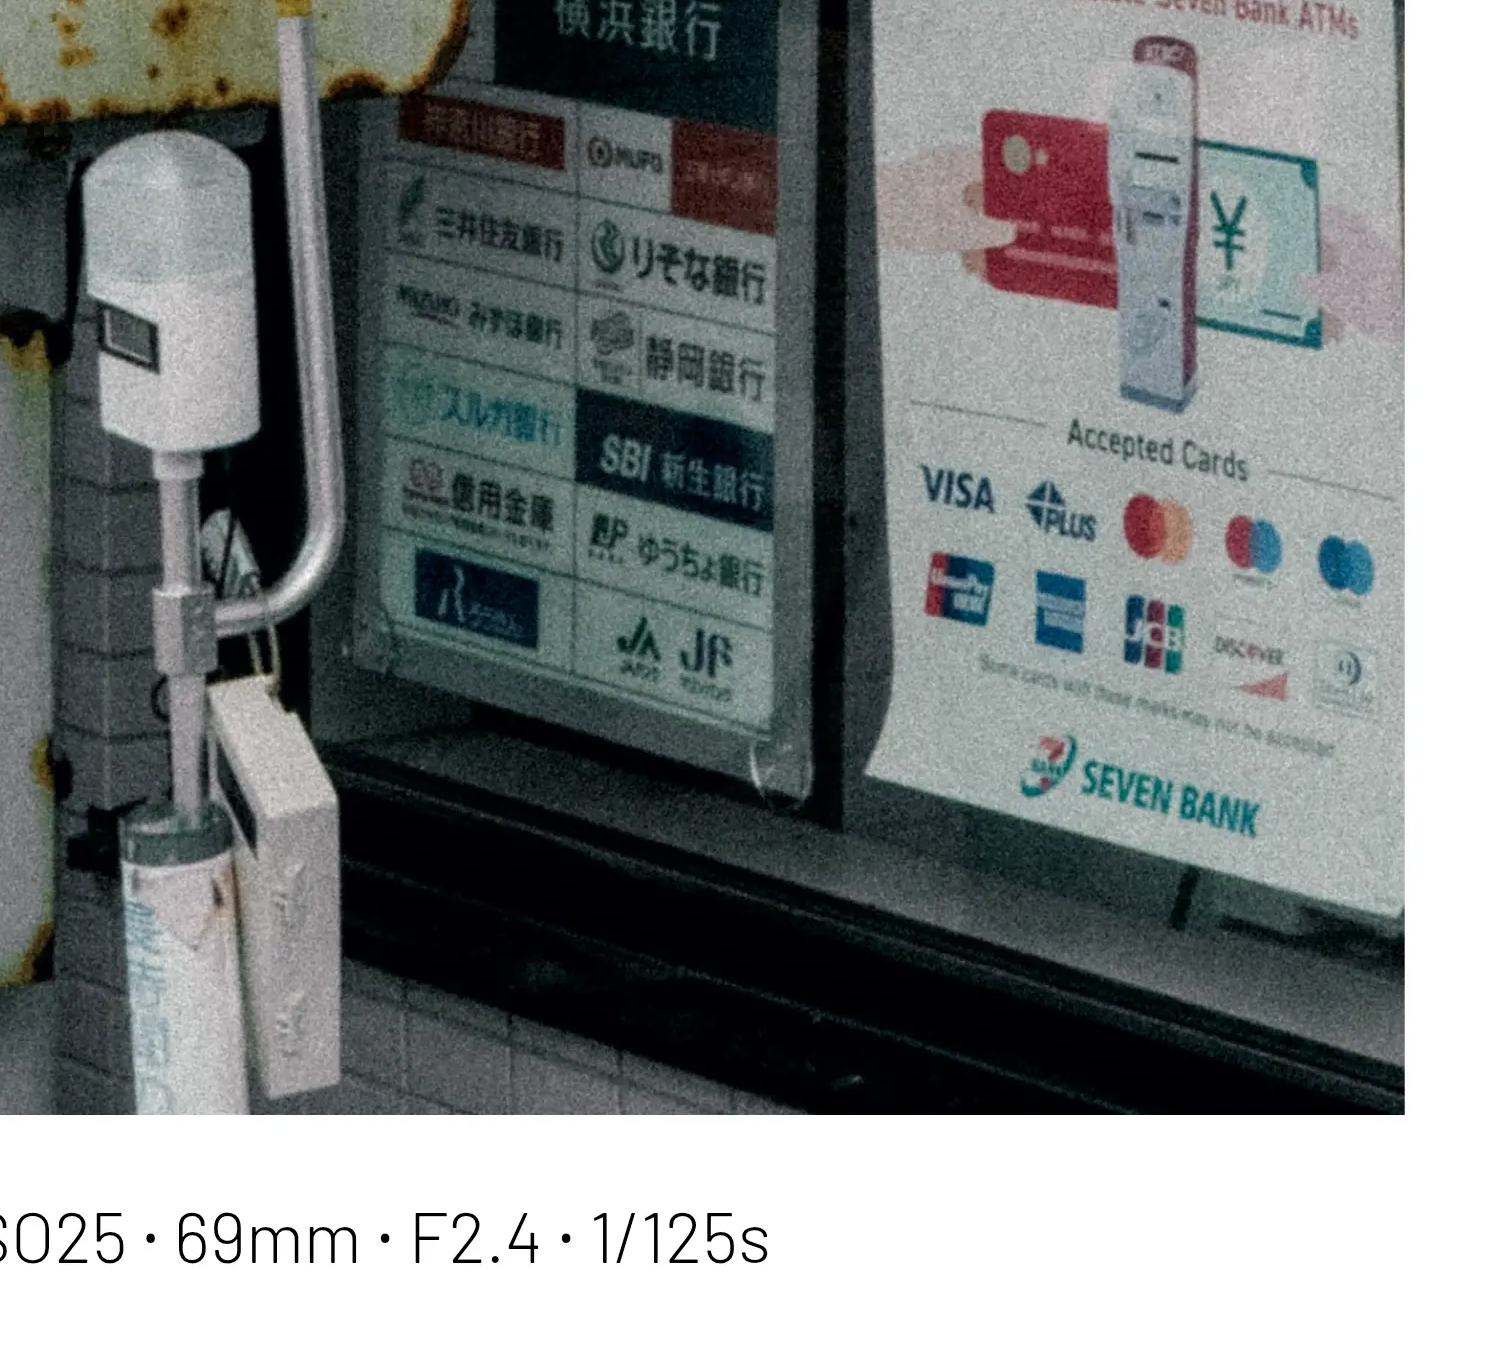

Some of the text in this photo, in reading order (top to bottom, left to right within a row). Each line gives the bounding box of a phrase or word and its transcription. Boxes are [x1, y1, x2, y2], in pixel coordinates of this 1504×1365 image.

[1296, 1, 1362, 41] ATMs
[435, 205, 565, 265] 三井住友銀行
[630, 235, 767, 306] りそな銀行
[645, 334, 767, 403] 静岡銀行
[441, 381, 563, 447] スルガ銀行
[600, 433, 769, 513] SBI 新生銀行
[1067, 418, 1250, 483] Accepted Cards
[451, 471, 556, 533] 信用金庫
[920, 464, 995, 514] VISA
[1042, 508, 1097, 543] PLUS
[637, 532, 765, 599] ゆうちょ銀行
[1081, 759, 1174, 816] SEVEN
[1180, 782, 1262, 839] BANK
